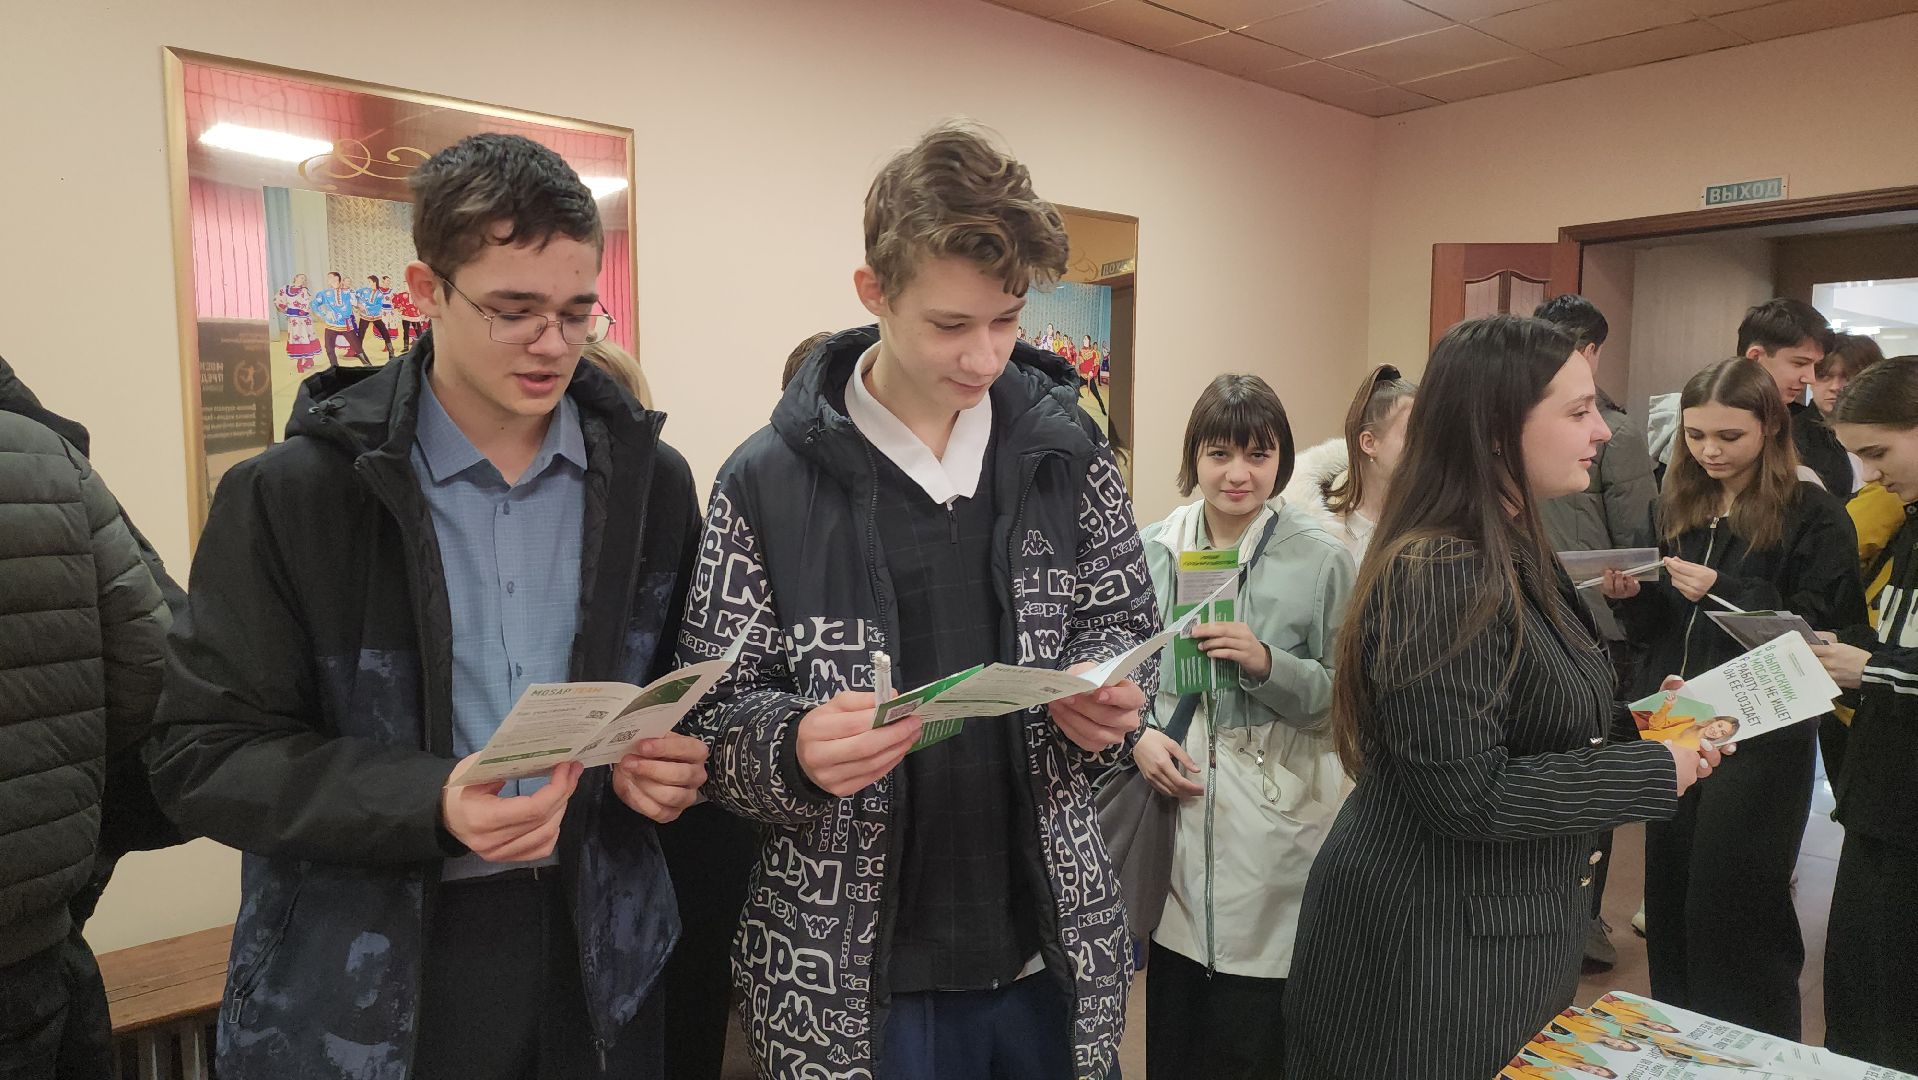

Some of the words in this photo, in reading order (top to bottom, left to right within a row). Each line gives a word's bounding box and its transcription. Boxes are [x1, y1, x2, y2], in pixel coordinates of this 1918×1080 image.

[1709, 180, 1780, 203] ВЫХОД
[1737, 663, 1760, 692] РАБОТУ
[1763, 653, 1798, 702] ВЫПУСКНИК
[1723, 668, 1737, 681] ОН
[1734, 691, 1761, 727] СОЗДАЁТ
[1764, 686, 1777, 699] НЕ
[1770, 697, 1791, 722] ИЩЕТ
